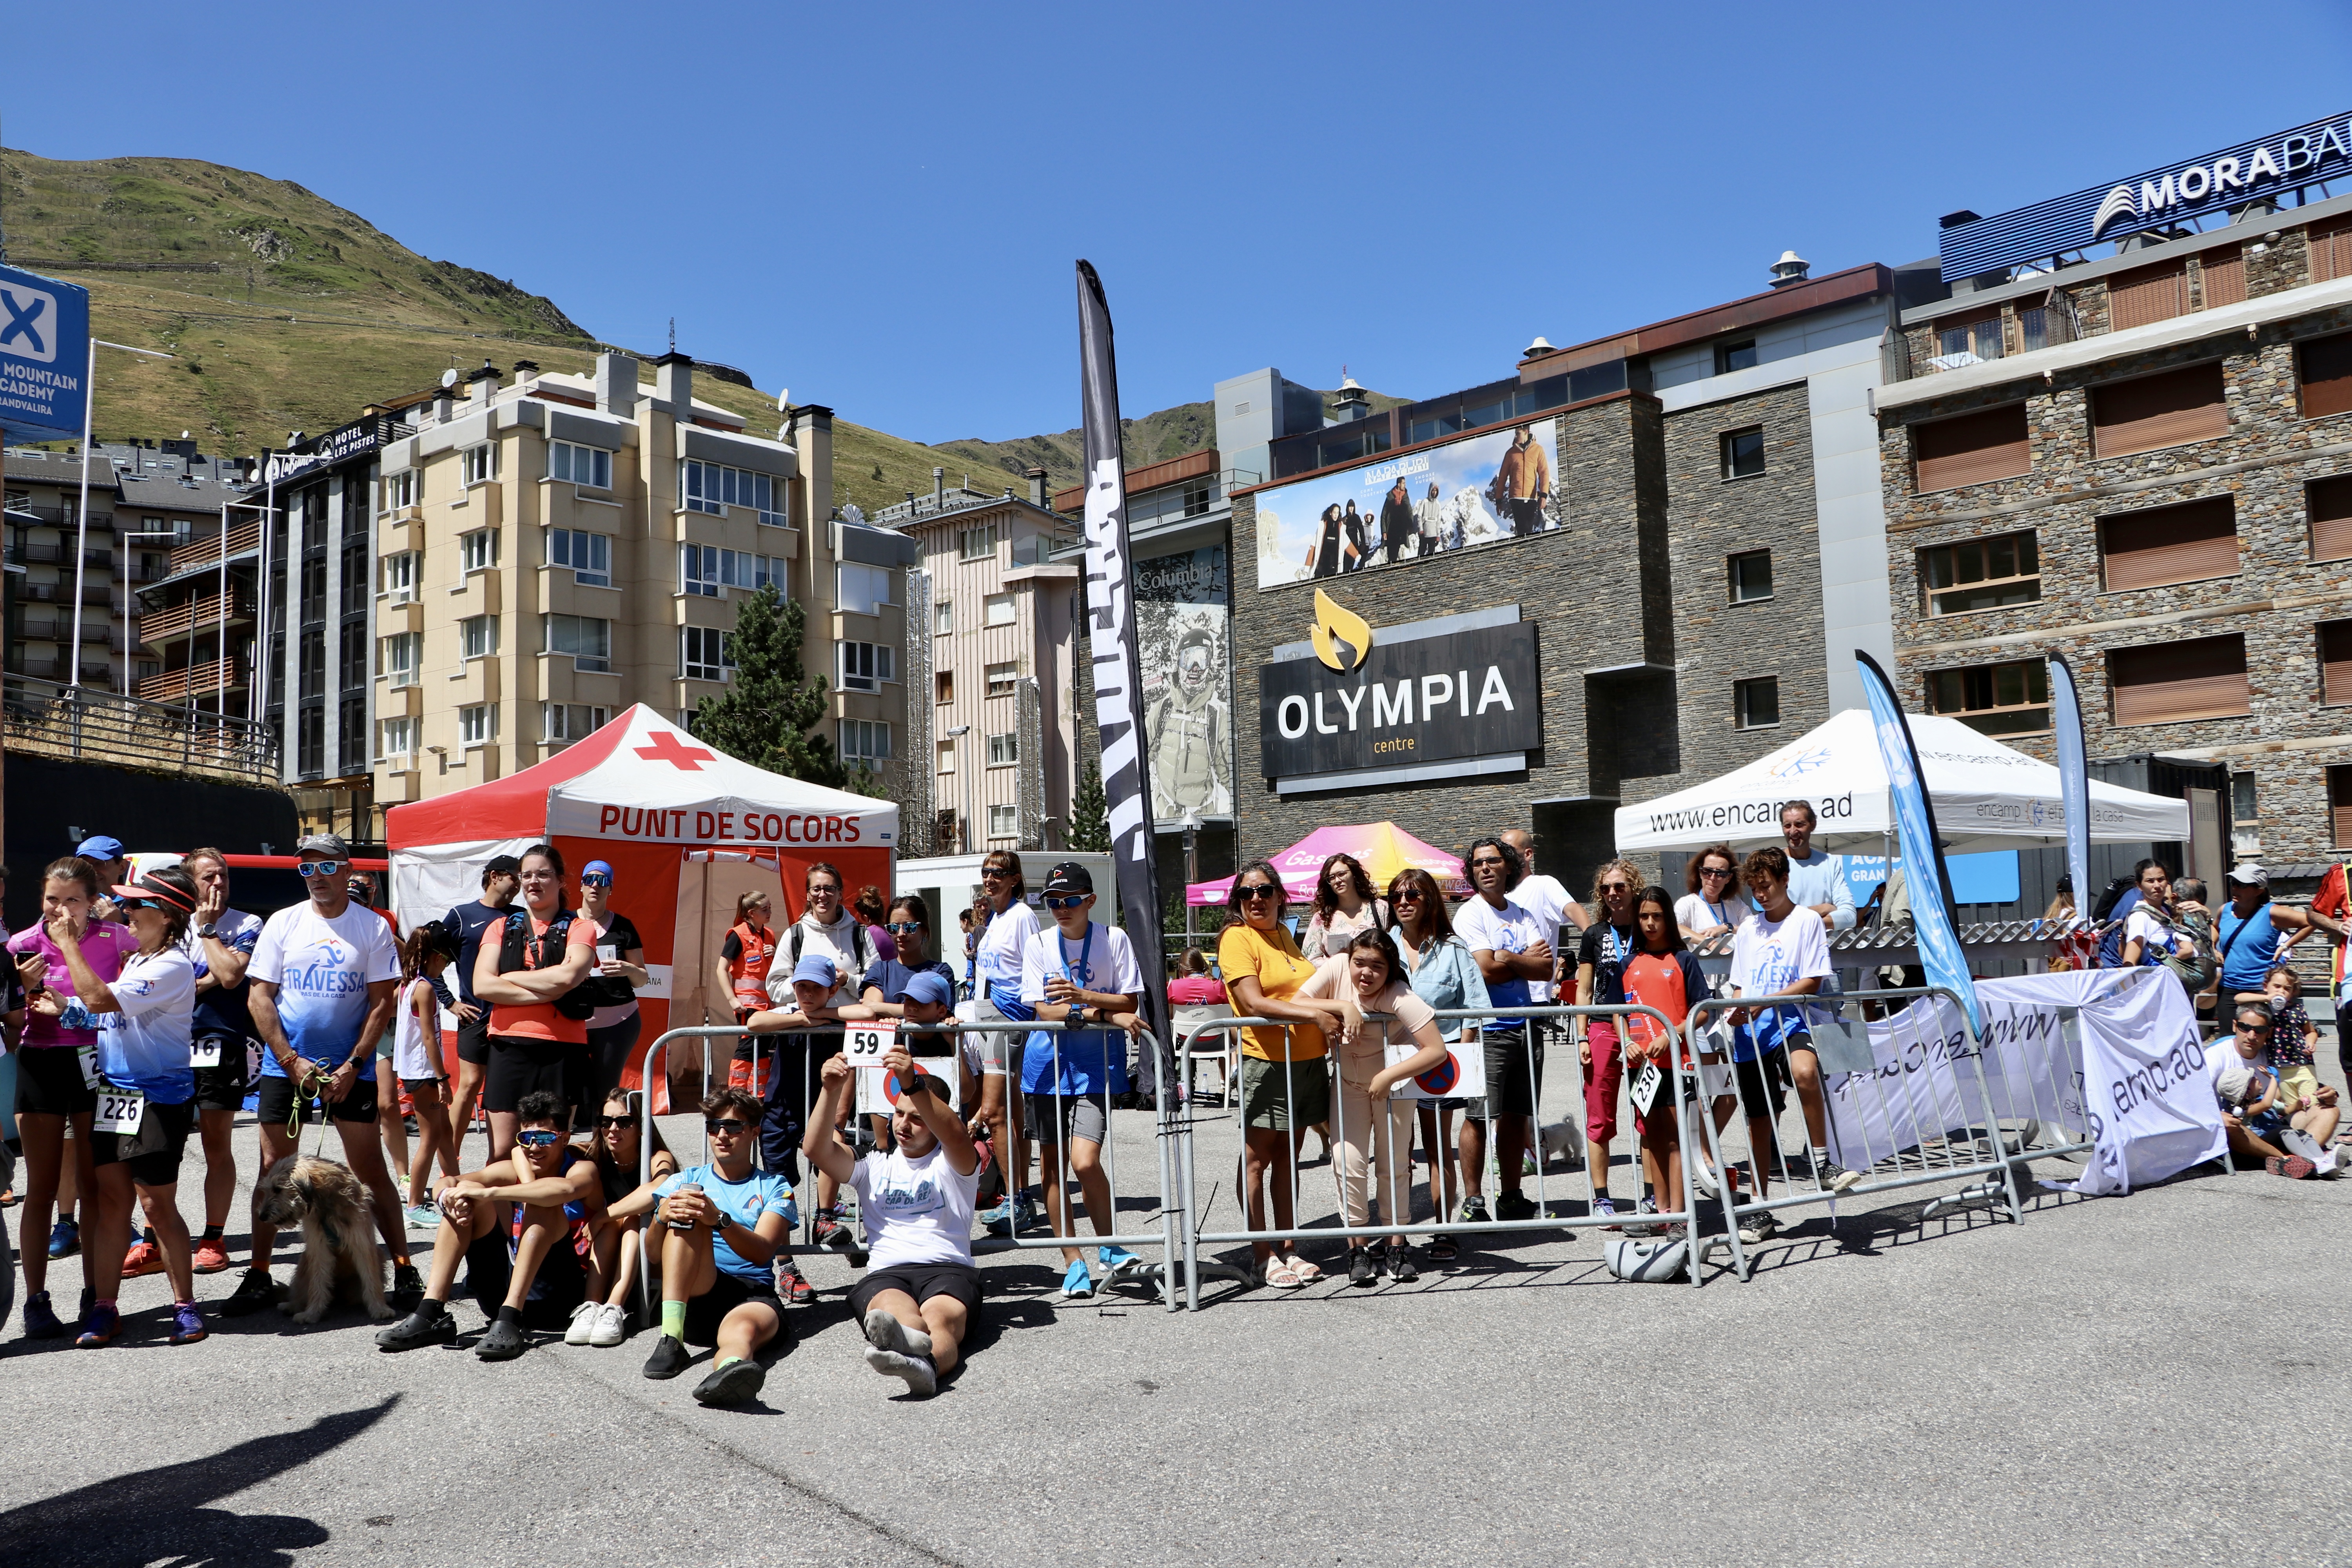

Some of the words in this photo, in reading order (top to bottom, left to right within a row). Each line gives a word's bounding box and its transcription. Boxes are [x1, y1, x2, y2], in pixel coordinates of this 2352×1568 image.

[2141, 119, 2352, 212] MORABA
[4, 361, 77, 391] MOUNTAIN
[334, 445, 347, 458] LES
[350, 434, 375, 452] PISTES
[335, 426, 362, 446] HOTEL
[1365, 455, 1429, 485] NAPAPIJRI
[1415, 472, 1435, 481] CHOOSE
[1416, 476, 1436, 485] FUTURE
[1361, 489, 1386, 498] TOGETHER
[1138, 561, 1214, 591] Columbia
[1278, 665, 1515, 740] OLYMPIA
[1374, 736, 1415, 754] centre
[1651, 790, 1852, 832] www.enca.ad
[1977, 804, 2020, 822] encamp
[2103, 809, 2123, 822] casa
[600, 806, 686, 838] PUNT
[696, 811, 733, 840] DE
[744, 813, 860, 842] SOCORS
[1049, 878, 1068, 887] Andorra
[286, 963, 365, 992] TRAVESSA
[1644, 1014, 1657, 1041] banyole
[854, 1032, 878, 1054] 59
[1637, 1066, 1655, 1103] 230
[104, 1097, 137, 1121] 226
[885, 1197, 902, 1205] CAP
